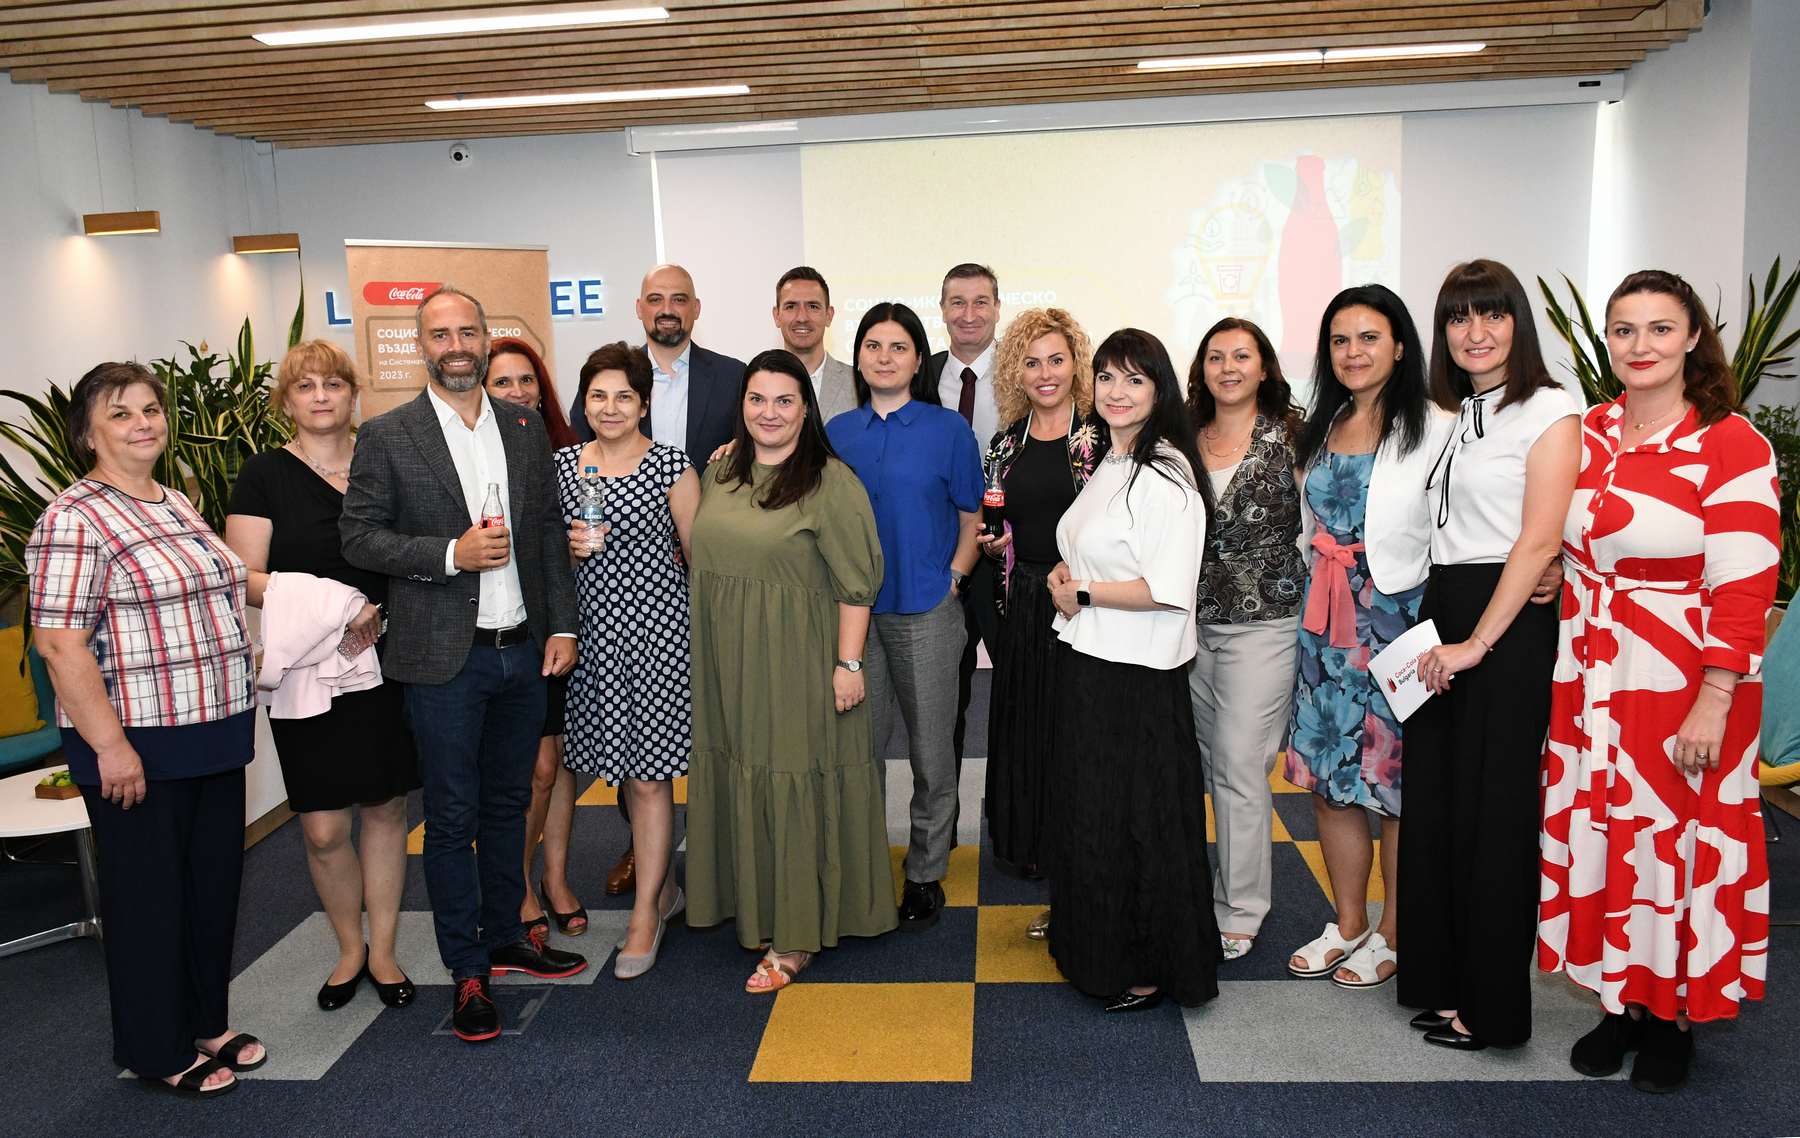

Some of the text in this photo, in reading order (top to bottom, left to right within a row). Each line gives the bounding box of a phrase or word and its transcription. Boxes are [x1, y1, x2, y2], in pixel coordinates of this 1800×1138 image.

[325, 279, 603, 325] L EE
[388, 287, 425, 301] Coca-Cola
[377, 343, 417, 355] ВЪЗДЕ
[1394, 658, 1417, 679] Coca-Cola
[1398, 669, 1415, 685] Bulgaria
